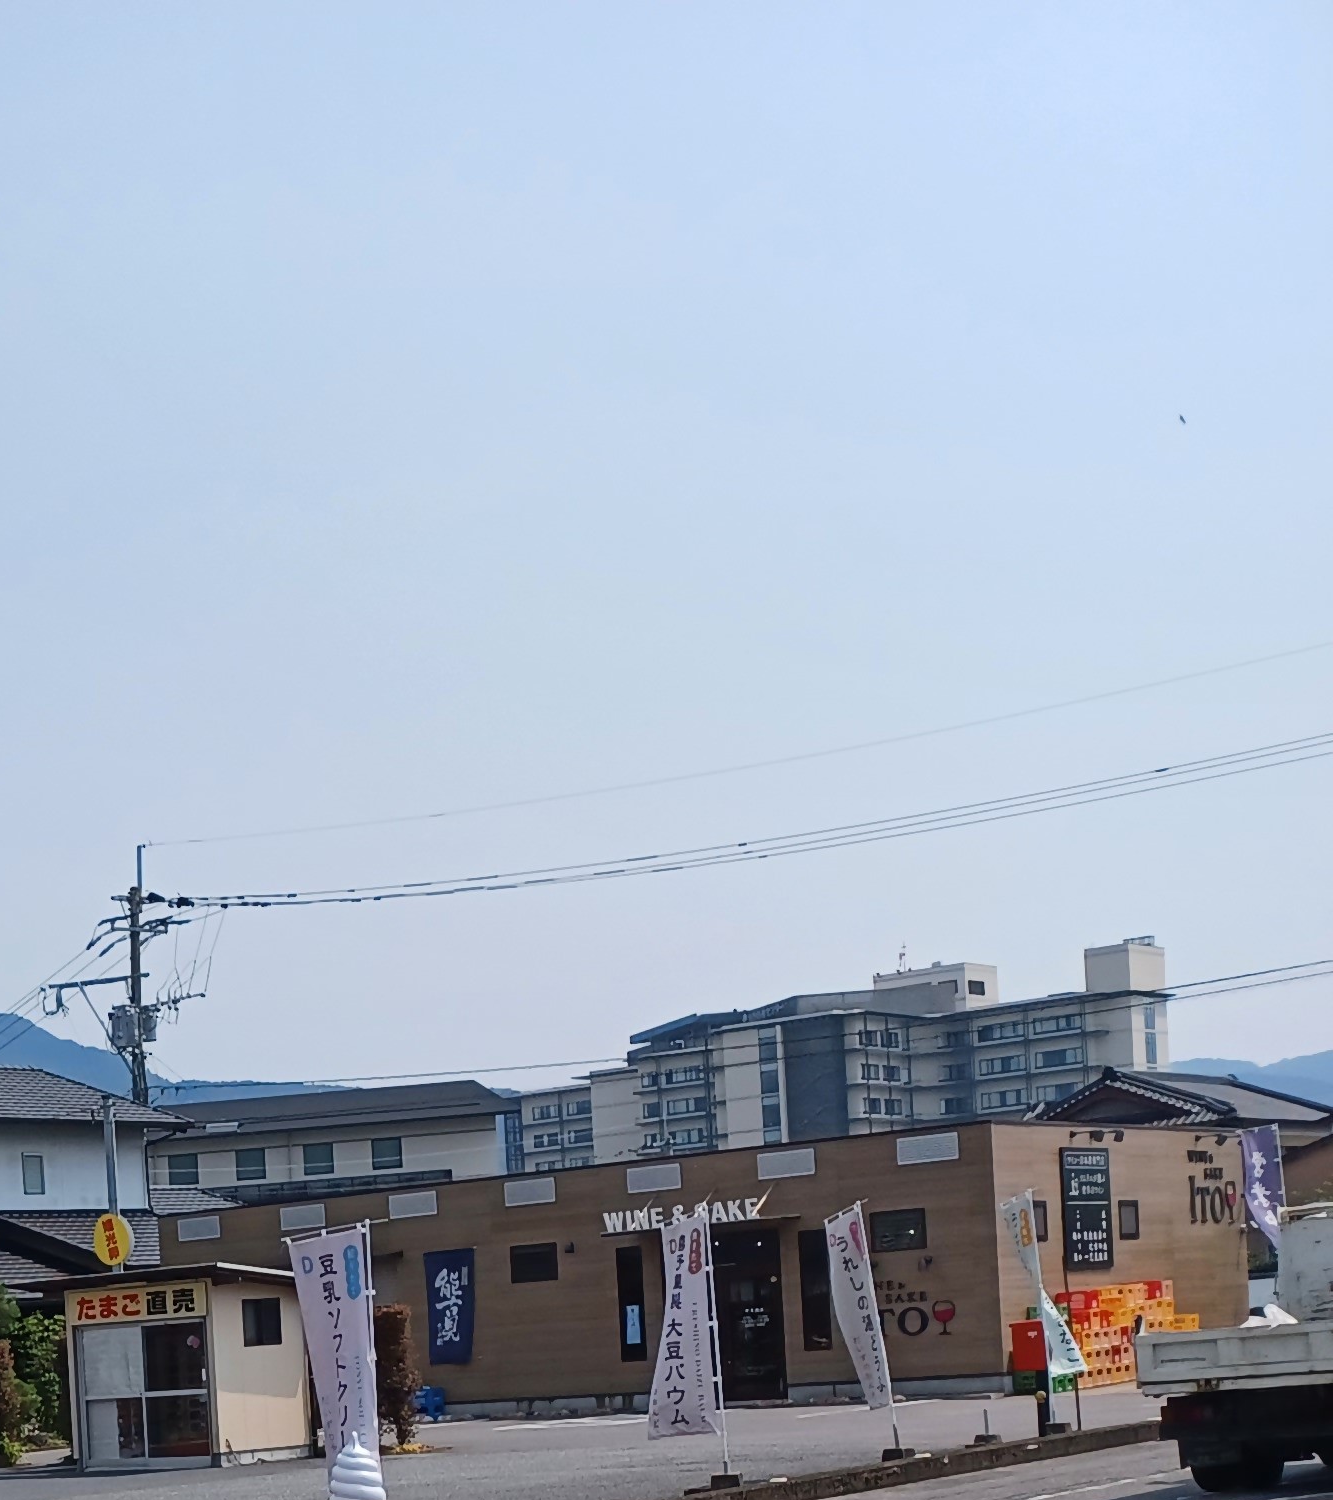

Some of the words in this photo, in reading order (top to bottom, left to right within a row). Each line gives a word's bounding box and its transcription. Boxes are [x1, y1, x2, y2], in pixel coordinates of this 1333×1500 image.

[1188, 1175, 1226, 1224] ITO
[602, 1207, 663, 1233] WINE
[76, 1288, 196, 1321] たまご直売
[879, 1306, 930, 1338] TO
[318, 1253, 347, 1448] 豆乳ソフトクリー
